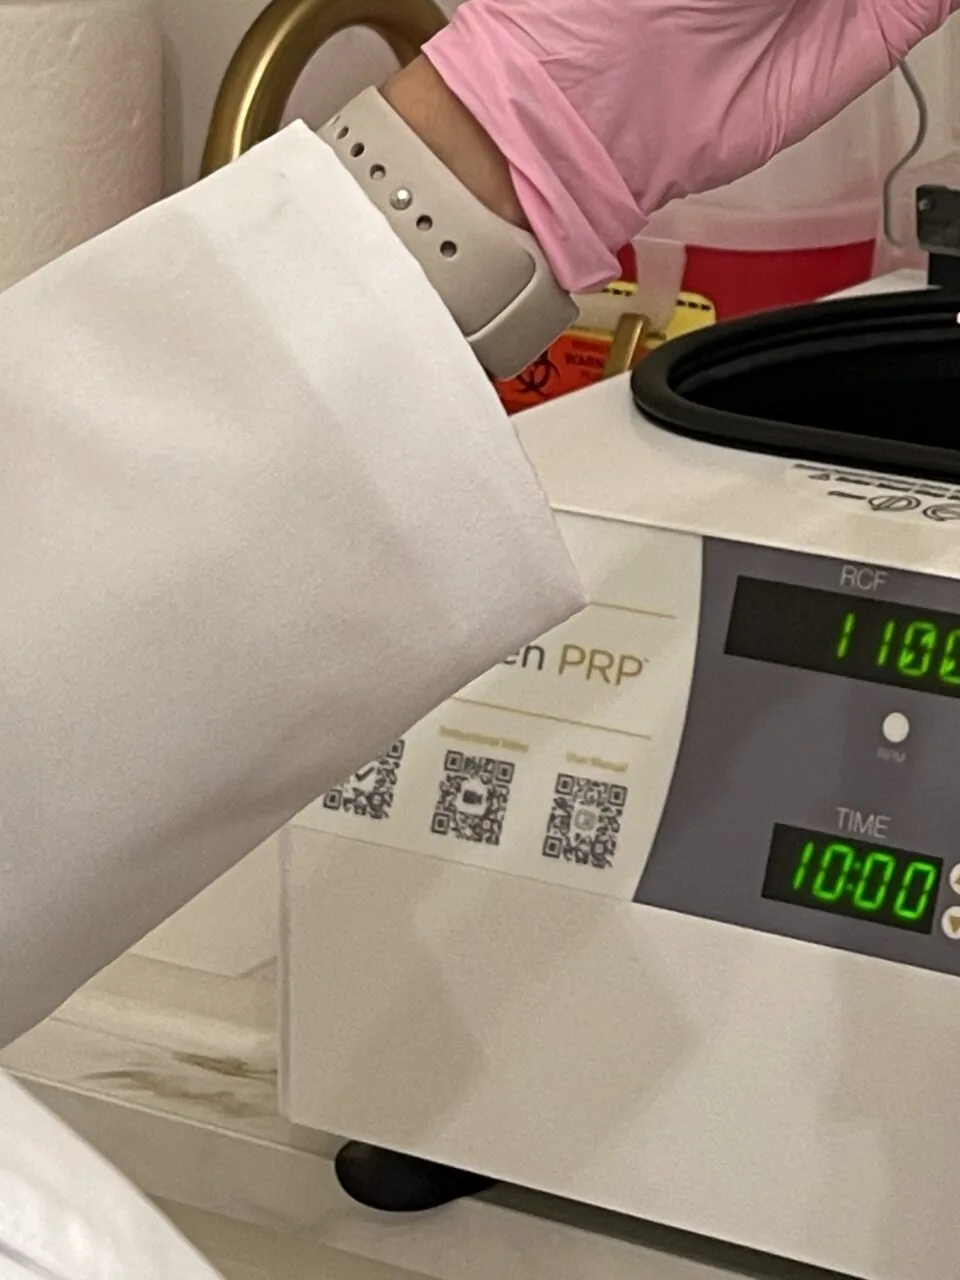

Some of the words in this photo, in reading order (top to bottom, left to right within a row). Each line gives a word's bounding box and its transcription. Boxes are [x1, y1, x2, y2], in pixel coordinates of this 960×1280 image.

[840, 565, 888, 591] RCF
[557, 643, 643, 686] PRP
[836, 806, 892, 839] TIME
[793, 841, 937, 920] 10:00
